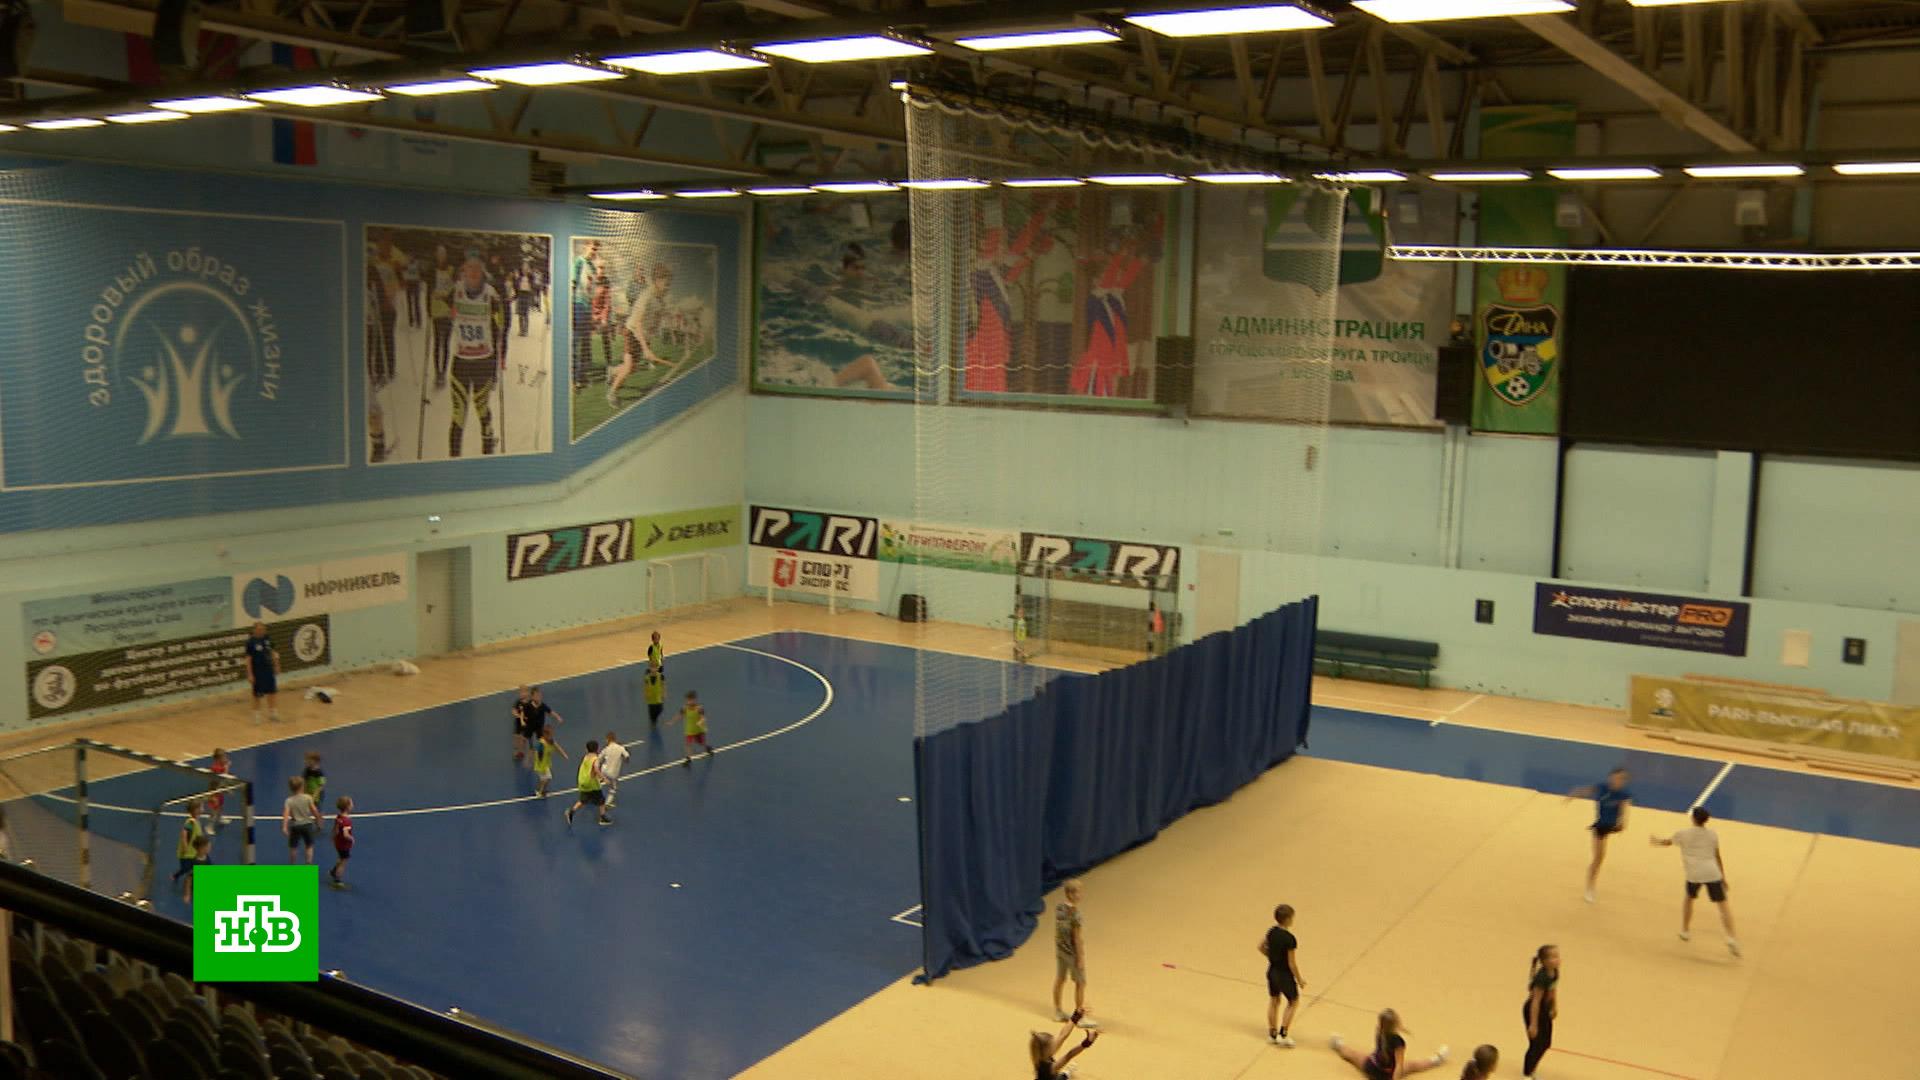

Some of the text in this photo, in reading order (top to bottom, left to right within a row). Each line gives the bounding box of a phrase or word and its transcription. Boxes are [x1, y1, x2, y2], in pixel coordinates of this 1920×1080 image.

[82, 247, 282, 407] здоровый образ жизни
[1217, 316, 1425, 342] АДМИНИСТРАЦИЯ
[668, 520, 732, 541] DEMIX
[752, 509, 876, 556] PARI
[510, 521, 632, 579] PARI
[1028, 536, 1179, 591] PARI
[304, 572, 401, 599] НОРНИКЕЛЬ
[1683, 607, 1728, 624] PRO
